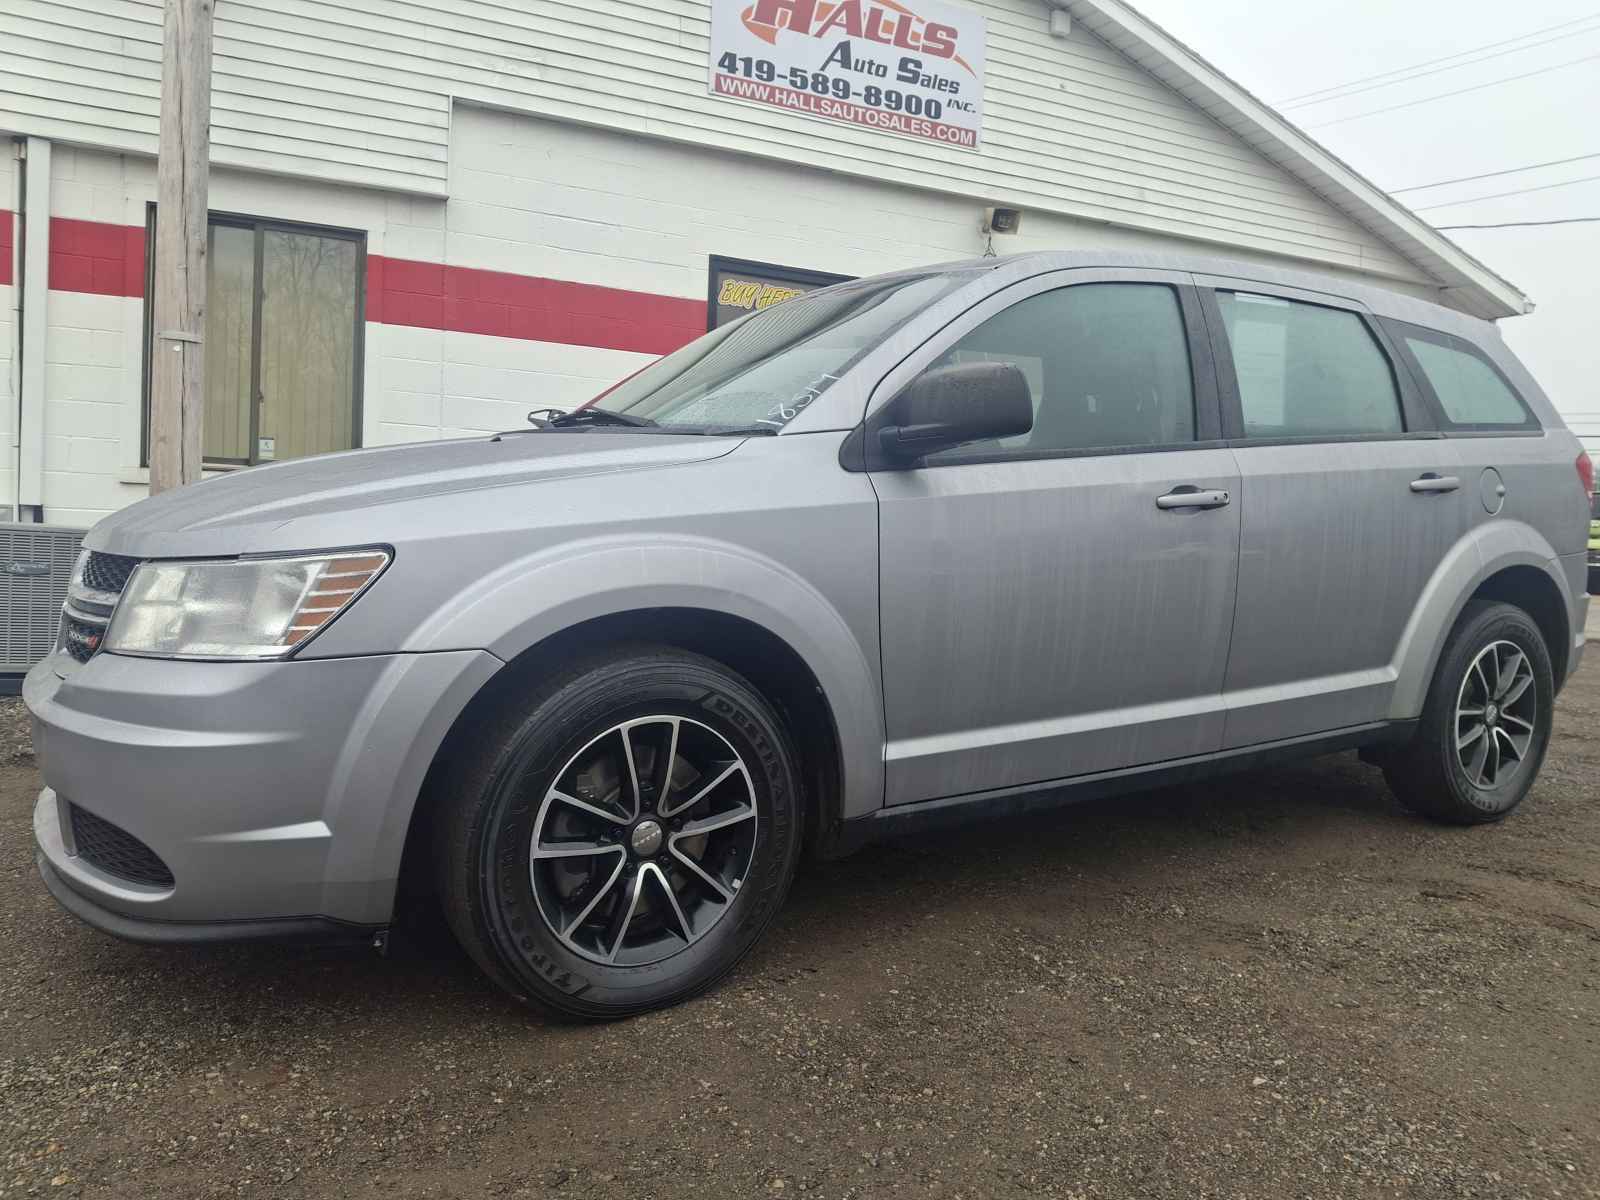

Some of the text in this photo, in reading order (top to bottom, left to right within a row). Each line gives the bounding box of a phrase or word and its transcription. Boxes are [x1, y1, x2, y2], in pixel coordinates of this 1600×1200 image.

[749, 0, 959, 60] HALLS
[717, 51, 942, 120] 419-589-8900
[720, 77, 974, 145] WWW.HALLSAUTOSALES.COM
[719, 280, 801, 309] BUY HE
